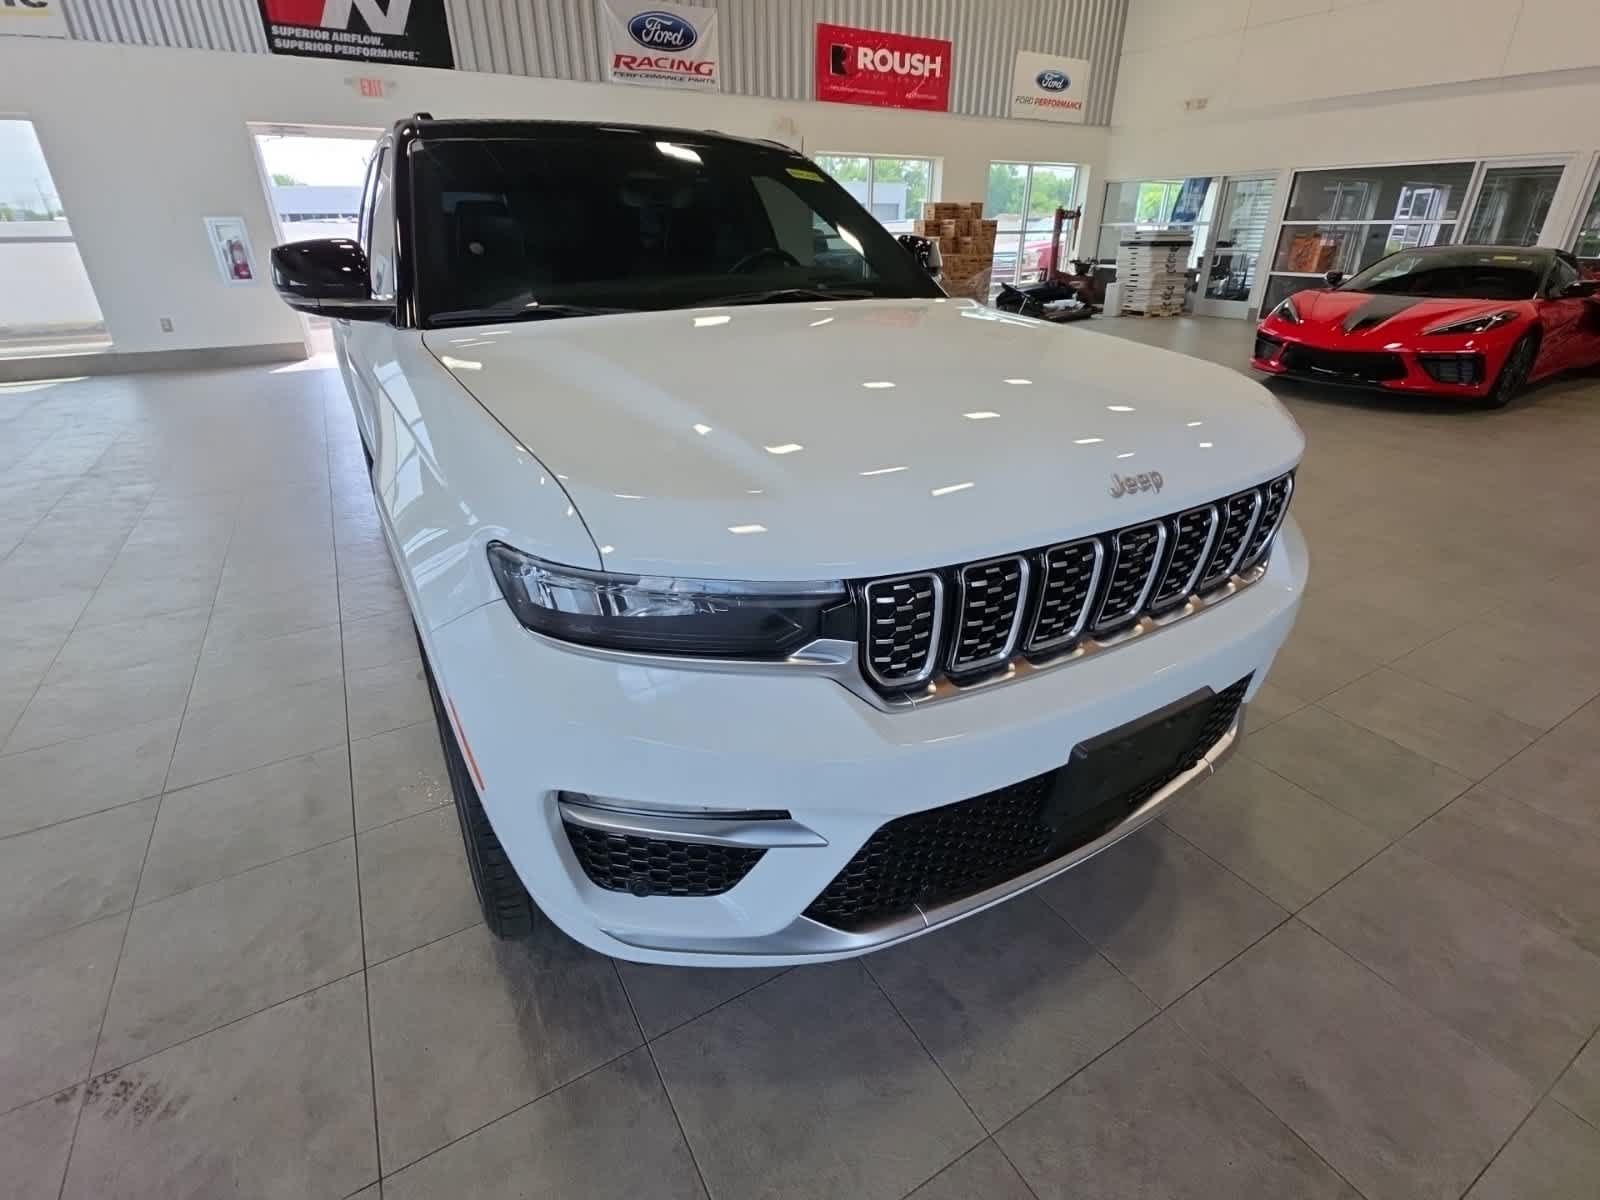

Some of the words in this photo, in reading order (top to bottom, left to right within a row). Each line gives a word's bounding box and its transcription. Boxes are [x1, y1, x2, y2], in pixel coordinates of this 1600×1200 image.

[271, 25, 330, 41] SUPERIOR
[331, 31, 384, 47] AIRFLOW.
[641, 16, 685, 46] Ford
[274, 38, 333, 54] SUPERIOR
[613, 54, 715, 77] RACING
[857, 46, 941, 78] ROUSH
[613, 71, 685, 82] PERFORMANCE
[687, 76, 715, 84] PARTS
[1041, 71, 1065, 89] Ford
[1015, 95, 1034, 105] FORD
[1034, 97, 1082, 111] PERFORMANCE
[1110, 470, 1163, 498] Jeep
